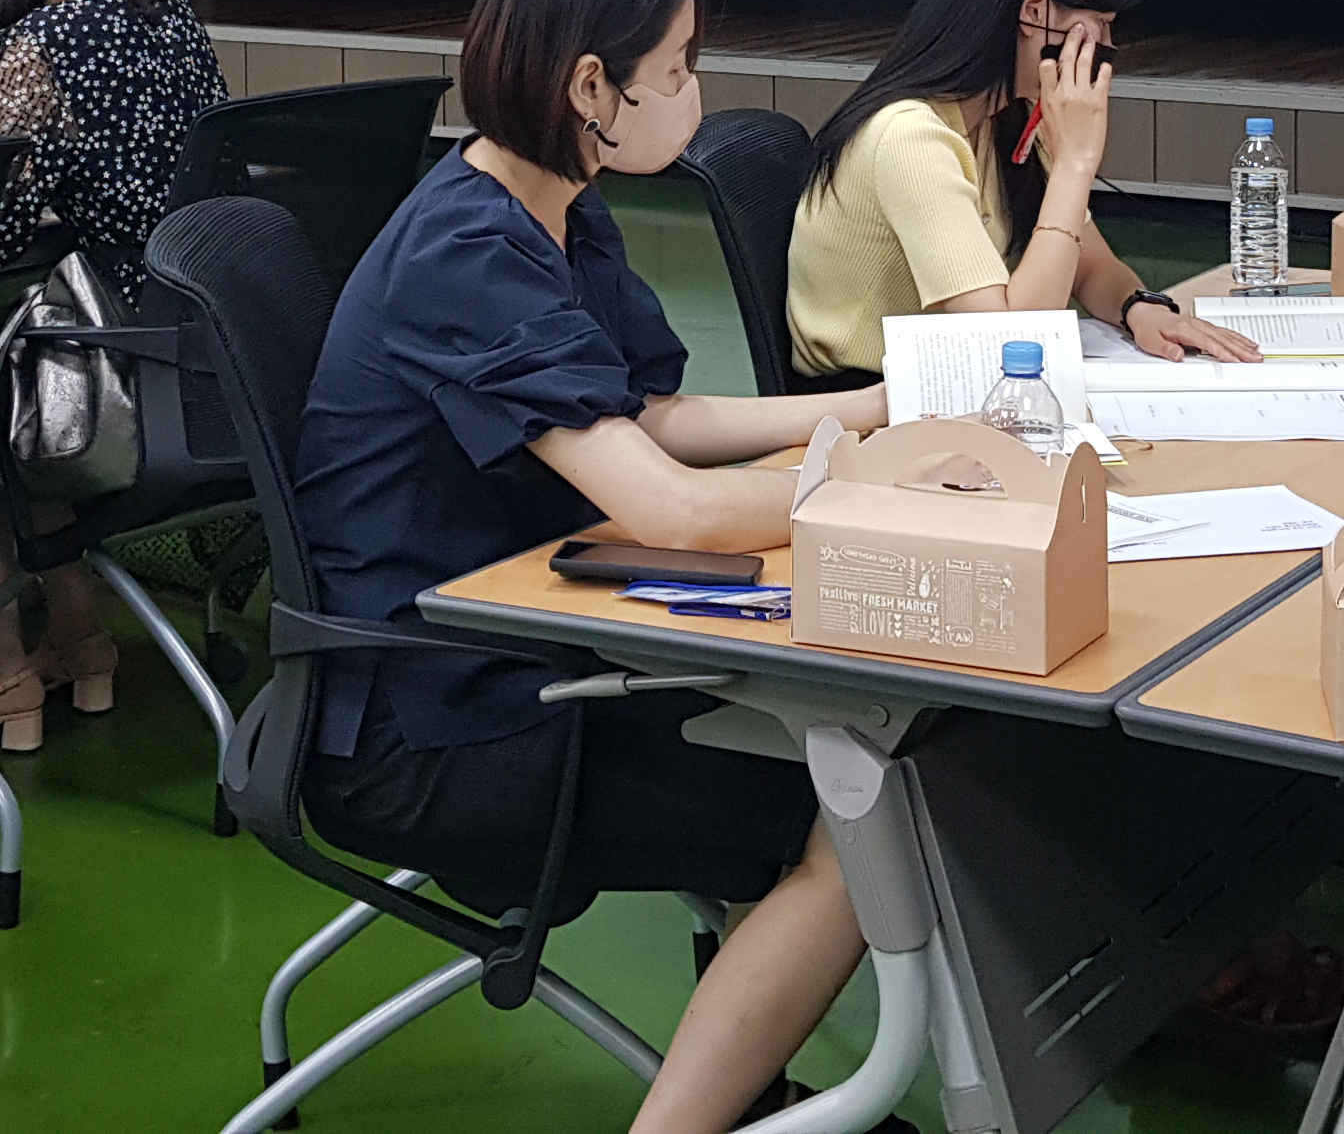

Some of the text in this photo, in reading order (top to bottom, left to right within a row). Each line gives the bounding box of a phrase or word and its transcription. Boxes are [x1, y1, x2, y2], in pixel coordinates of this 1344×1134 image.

[862, 593, 938, 613] FRESH MARKET
[862, 610, 895, 637] LOVE
